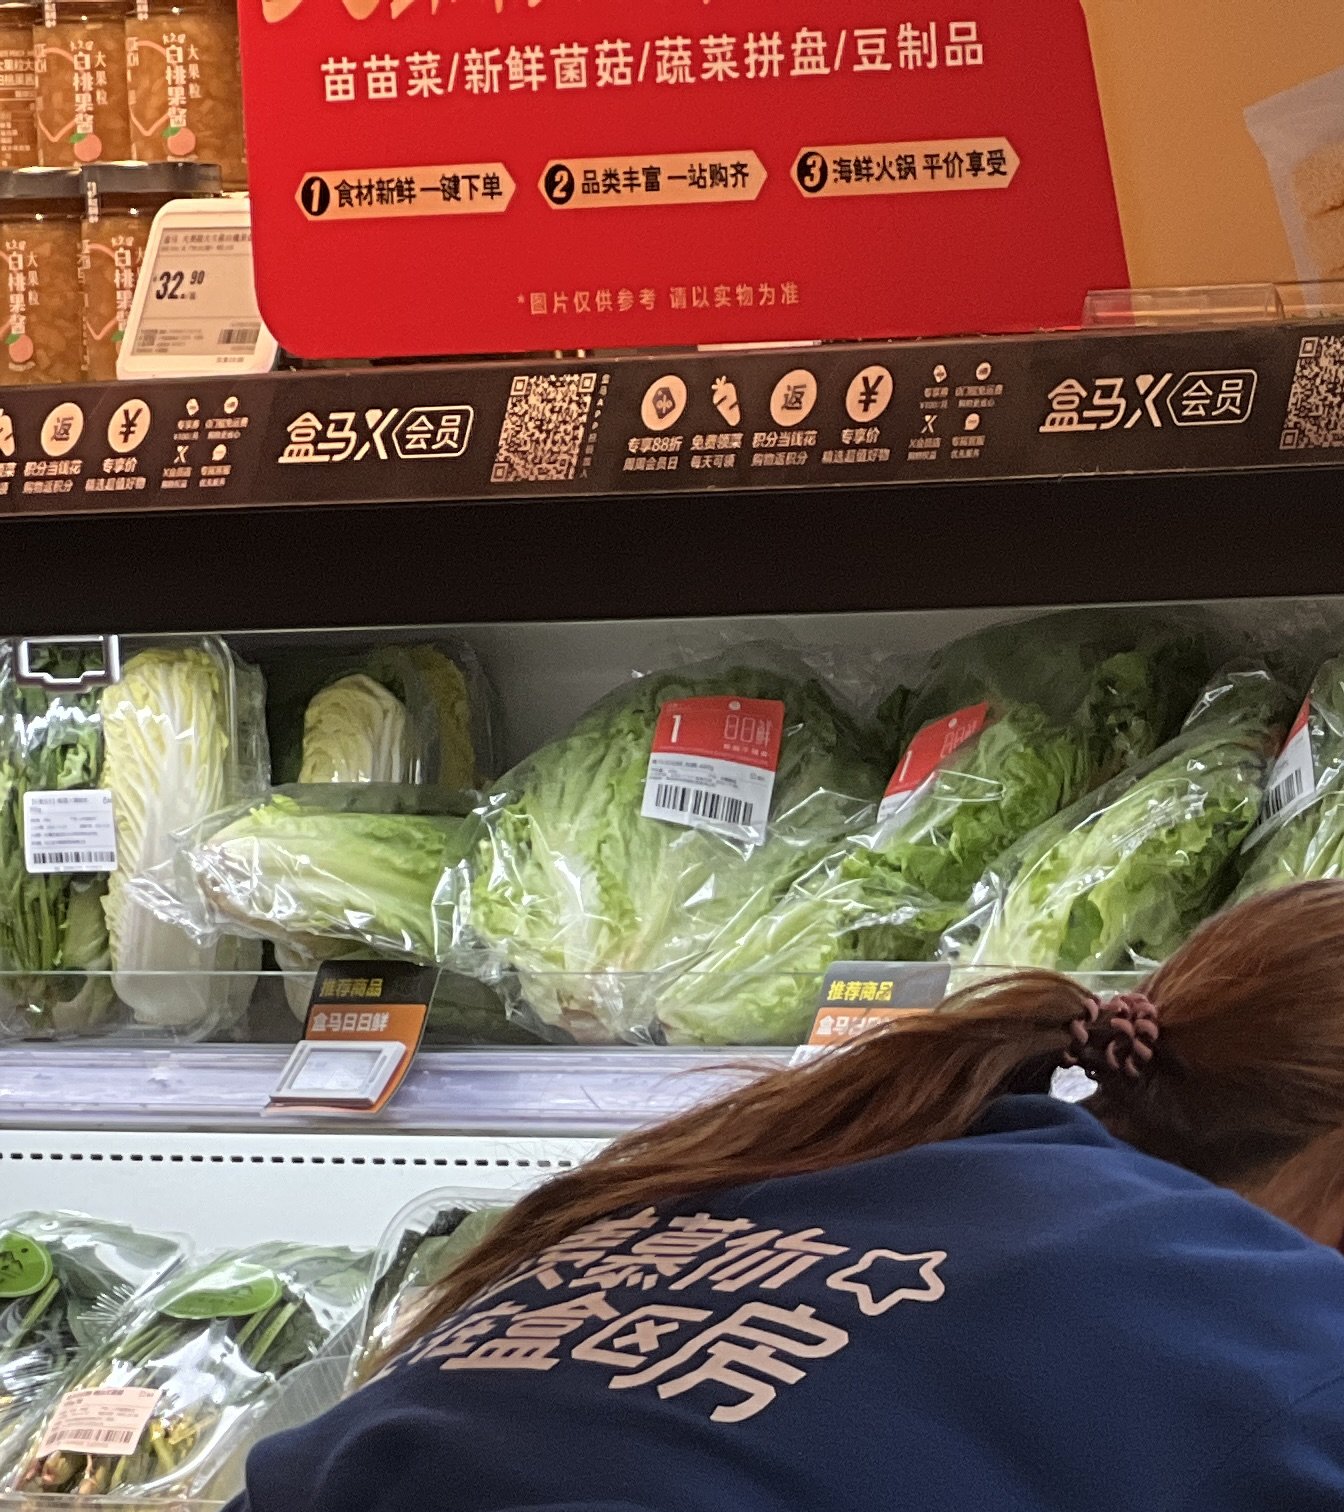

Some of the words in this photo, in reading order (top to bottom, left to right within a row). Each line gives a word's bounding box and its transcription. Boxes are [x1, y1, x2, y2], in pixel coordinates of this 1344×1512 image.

[581, 165, 661, 195] 品类丰富
[667, 161, 750, 191] 一站购齐
[832, 155, 917, 185] 海鲜火锅
[922, 149, 1008, 180] 平价享受
[334, 179, 416, 208] 食材新鲜
[419, 172, 502, 203] 一键下单
[669, 281, 800, 310] 请以实物为准
[627, 435, 684, 454] 专享88折
[320, 978, 383, 997] 推荐商品
[827, 980, 894, 1001] 推荐商品
[311, 1012, 389, 1034] 盒马日日鲜
